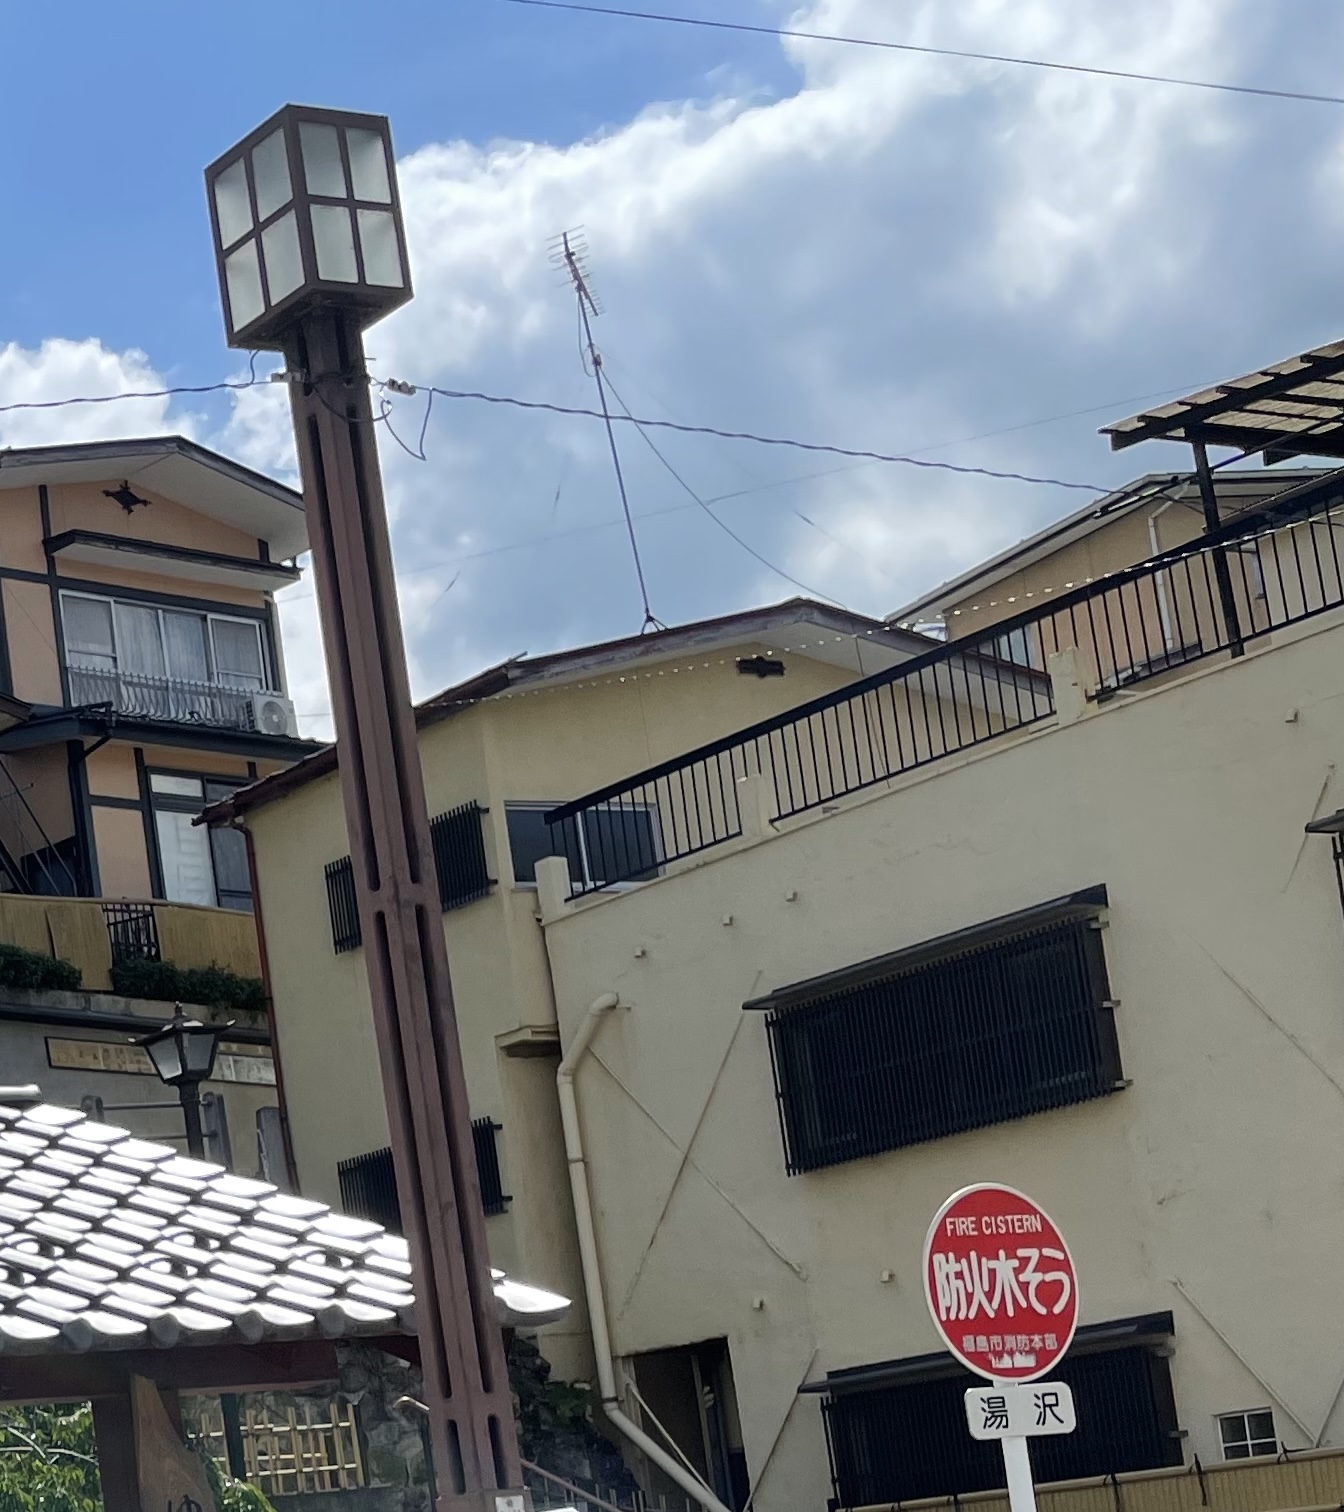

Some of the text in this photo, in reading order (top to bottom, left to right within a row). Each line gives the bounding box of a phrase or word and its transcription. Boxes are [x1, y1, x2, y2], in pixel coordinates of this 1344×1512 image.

[945, 1213, 1043, 1238] FIRE CISTERN
[979, 1391, 1065, 1431] 湯沢
